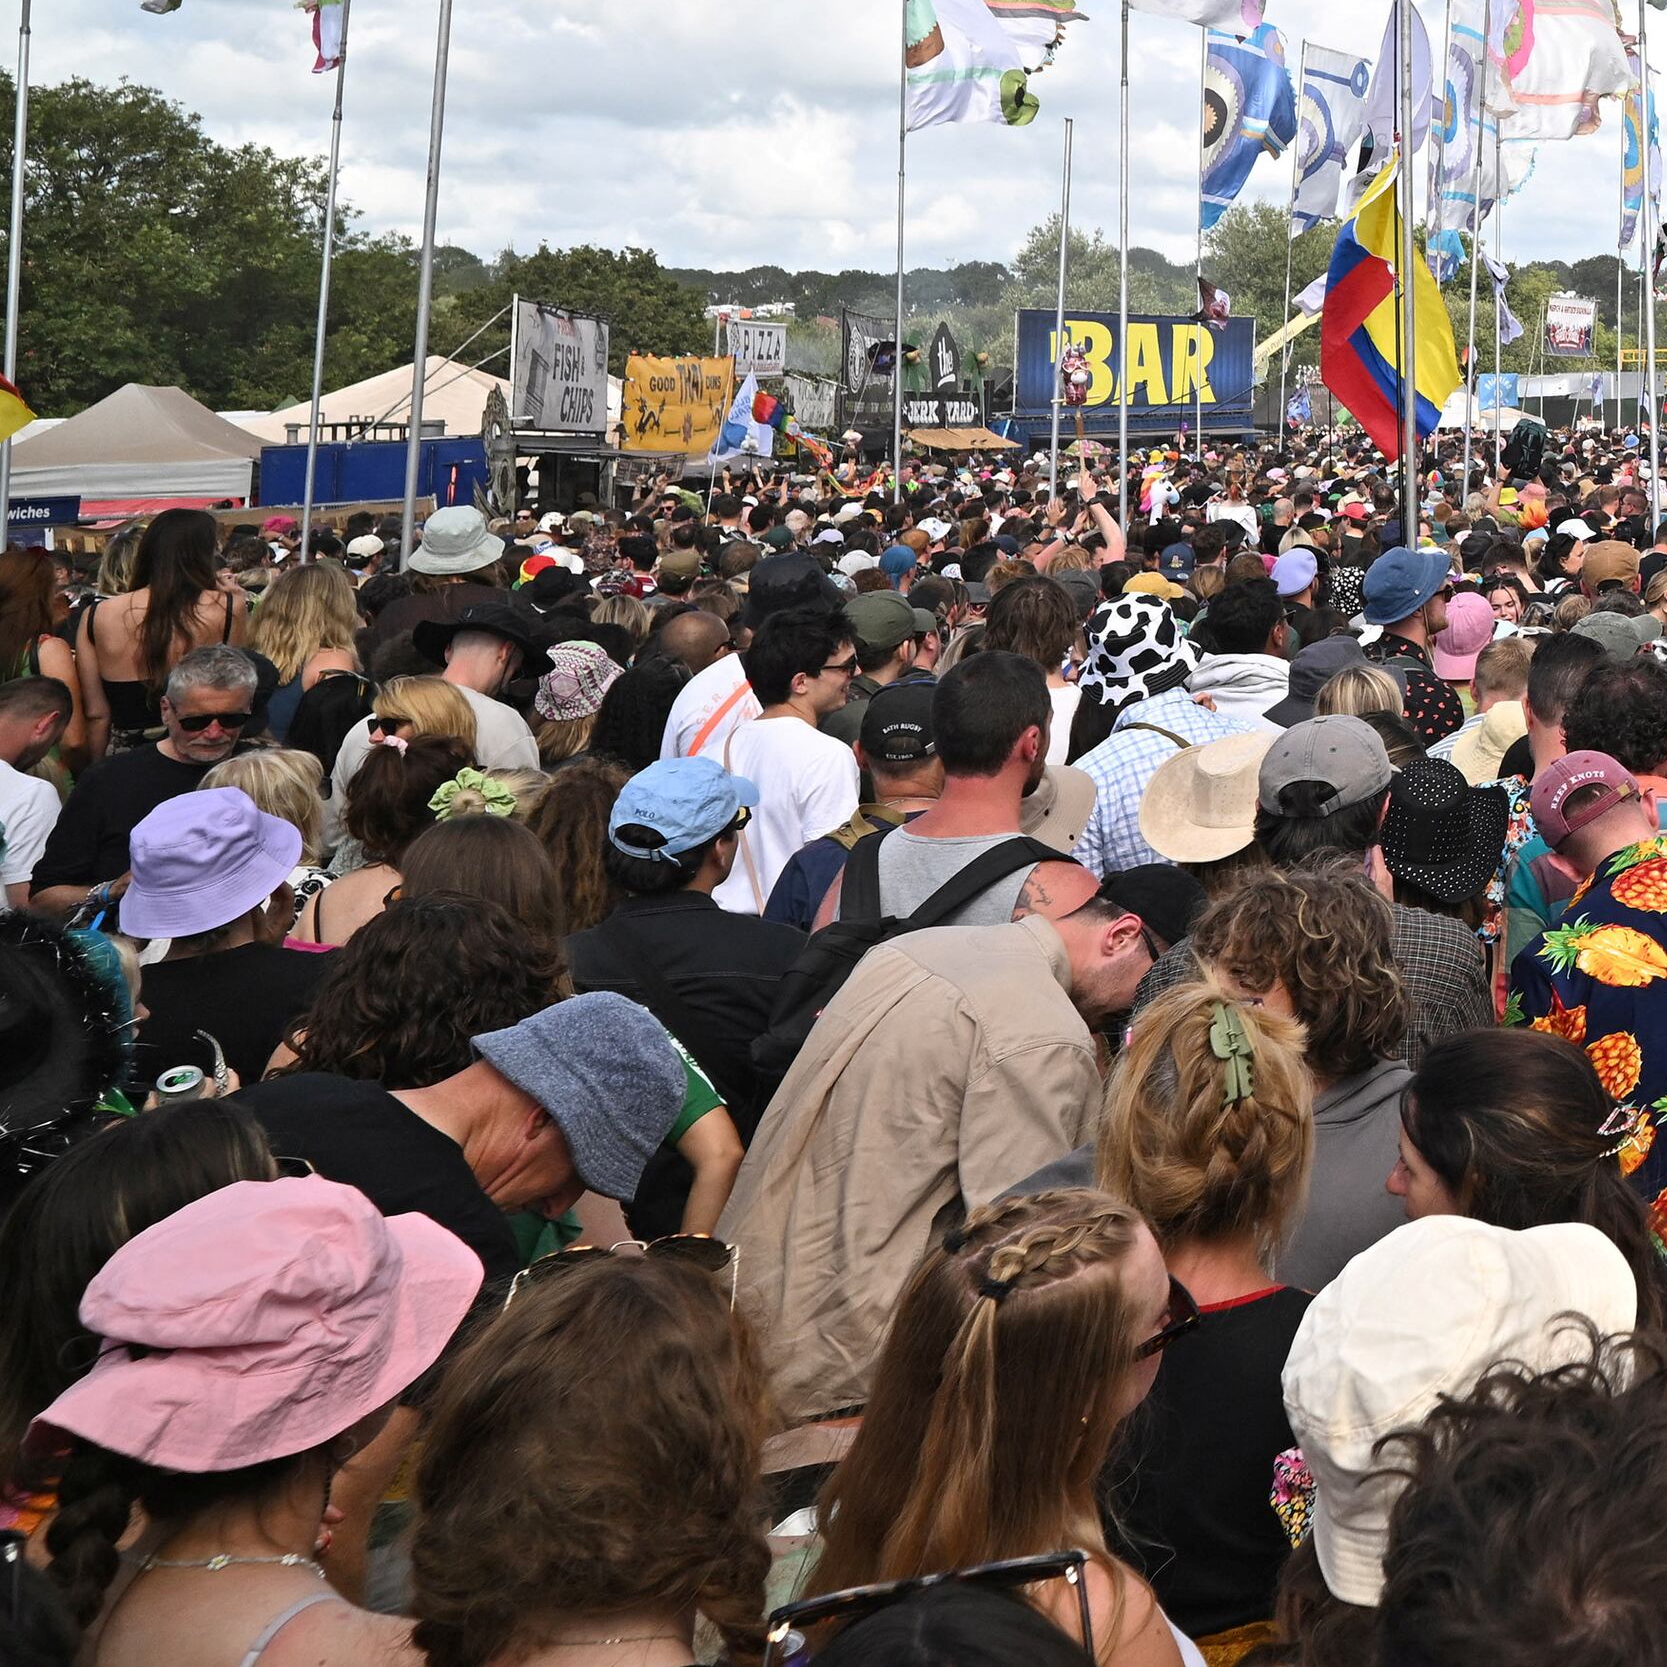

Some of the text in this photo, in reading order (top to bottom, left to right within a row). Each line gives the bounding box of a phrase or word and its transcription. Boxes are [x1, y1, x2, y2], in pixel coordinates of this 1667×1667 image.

[552, 342, 581, 382] FISH
[743, 330, 781, 360] PIZZA
[937, 336, 954, 377] the
[1062, 320, 1217, 407] BAR
[649, 376, 676, 392] GOOD
[560, 385, 594, 424] CHIPS
[907, 400, 940, 424] JERK
[944, 400, 975, 423] YARD
[882, 723, 923, 734] BATH RUGBY
[1550, 770, 1605, 810] REEF KNOTS
[634, 808, 655, 819] POLO
